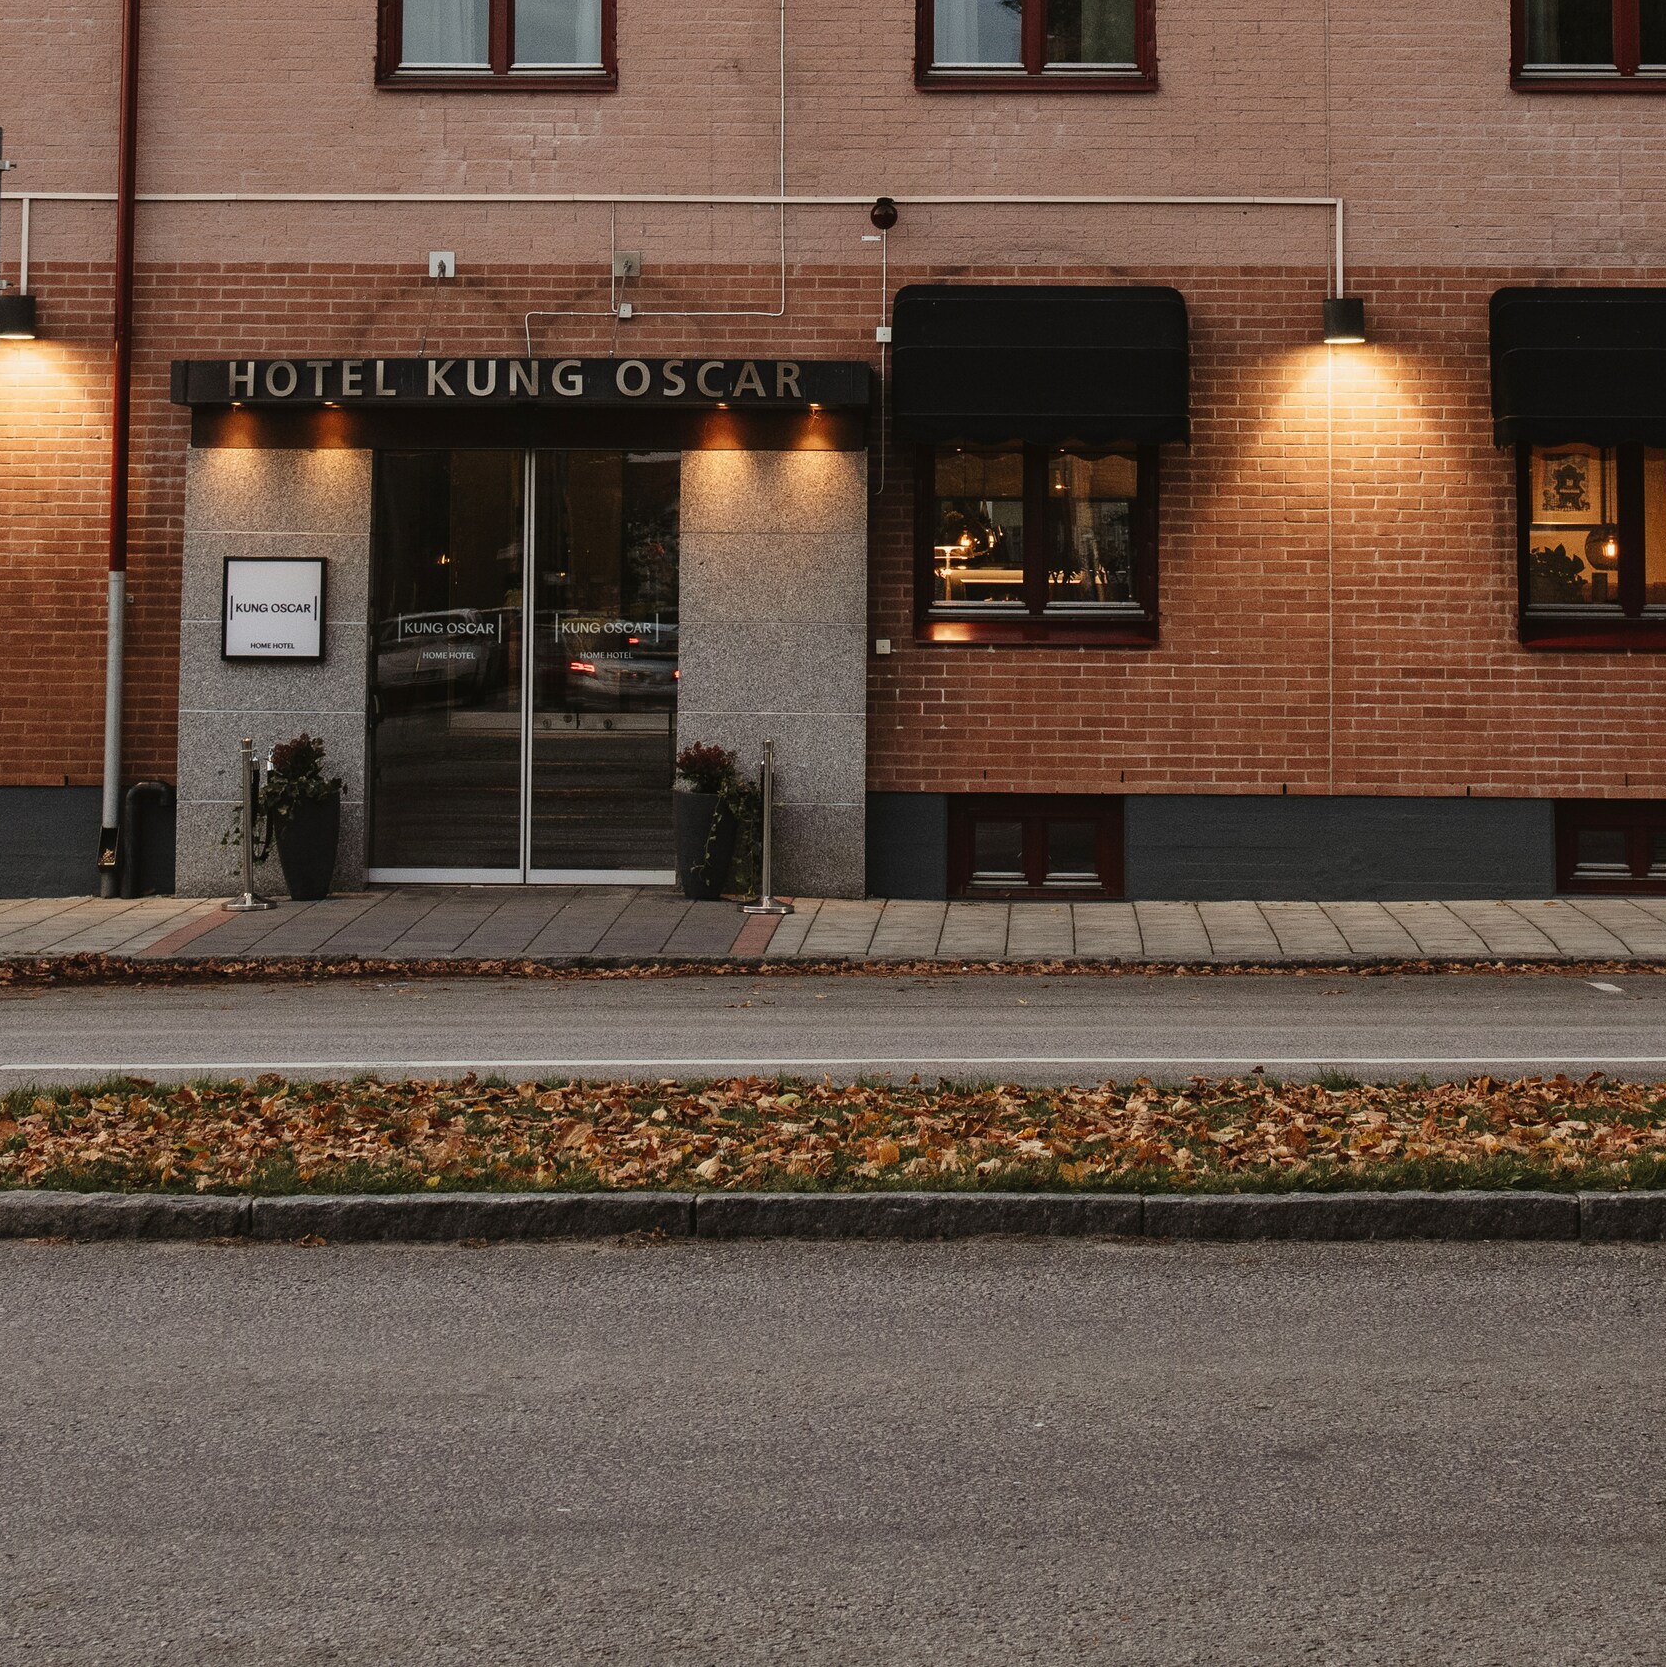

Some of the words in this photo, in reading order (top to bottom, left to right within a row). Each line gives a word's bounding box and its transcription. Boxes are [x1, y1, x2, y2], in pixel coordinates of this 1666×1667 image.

[228, 359, 397, 397] HOTEL
[426, 359, 584, 397] KUNG
[615, 359, 803, 398] OSCAR
[235, 603, 268, 613] KUNG
[270, 603, 312, 613] OSCAR
[404, 622, 444, 634] KUNG
[446, 622, 495, 635] OSCAR
[561, 622, 601, 634] KUNG
[603, 622, 652, 634] OSCAR
[422, 651, 448, 659] HOME
[449, 651, 476, 660] HOTEL
[579, 651, 605, 659] HOME
[606, 651, 634, 659] HOTEL
